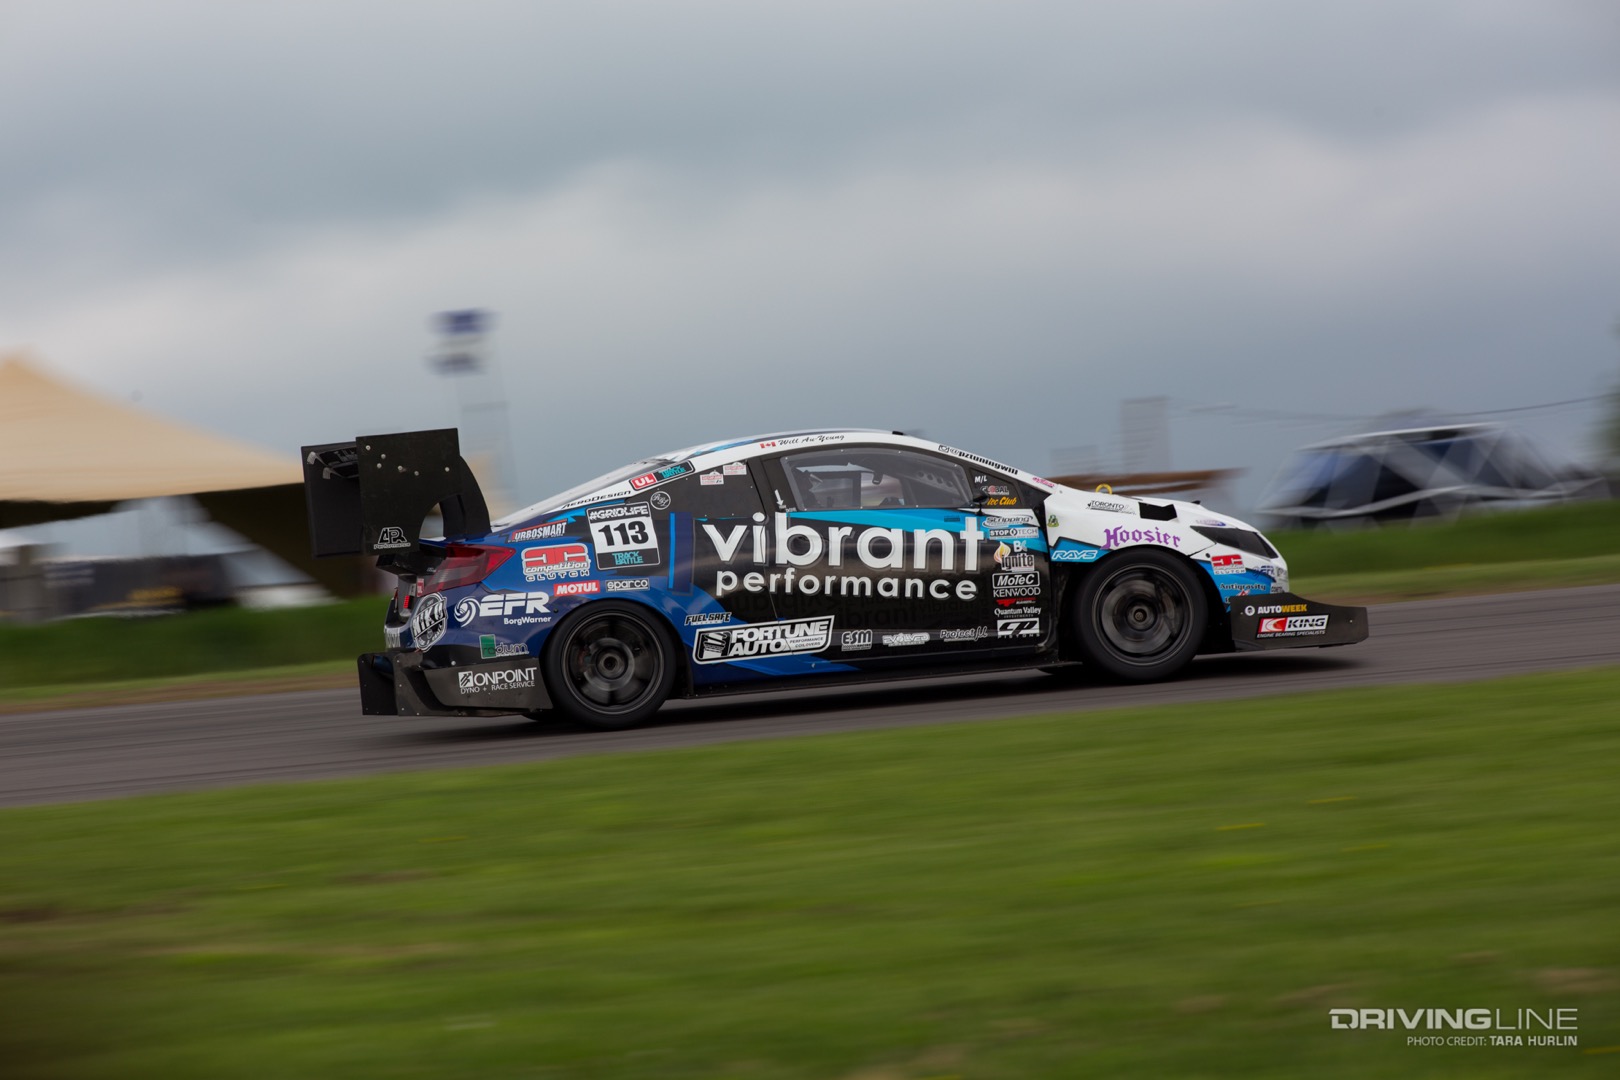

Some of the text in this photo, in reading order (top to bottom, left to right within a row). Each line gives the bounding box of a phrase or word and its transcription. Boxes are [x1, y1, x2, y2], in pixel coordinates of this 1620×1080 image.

[778, 438, 799, 446] Will
[634, 476, 654, 486] UL
[999, 496, 1017, 506] Club
[1091, 500, 1125, 510] TORONTO
[589, 505, 649, 520] #GRIDLIFE
[598, 520, 649, 546] 113
[1101, 525, 1181, 549] Hoosier
[702, 511, 985, 571] vibrant
[612, 550, 640, 559] TRACK
[615, 555, 644, 566] BATTLE
[1051, 549, 1098, 561] RAYS
[525, 561, 588, 573] competition
[1001, 553, 1034, 570] ignite
[526, 569, 590, 582] CLUTCH
[996, 573, 1035, 587] MoTeC
[556, 581, 598, 595] MOTUL
[606, 579, 648, 591] sparco
[715, 567, 978, 600] performance
[993, 587, 1041, 598] KENWOOD
[479, 591, 552, 617] EFR
[1257, 603, 1308, 615] AUTOWEEK
[994, 606, 1042, 617] Quantum Valley
[503, 616, 552, 626] BorgWarner
[684, 613, 707, 626] FUEL
[708, 612, 732, 623] SAFE
[1287, 617, 1326, 629] KING
[731, 620, 830, 644] FORTUNE
[842, 629, 872, 645] ESM
[940, 628, 976, 639] Project
[789, 636, 824, 644] PERFORMANCE
[728, 639, 787, 657] AUTO
[474, 667, 537, 686] ONPOINT
[460, 684, 480, 694] DYNO
[491, 683, 509, 691] RACE
[509, 680, 536, 689] SERVICE
